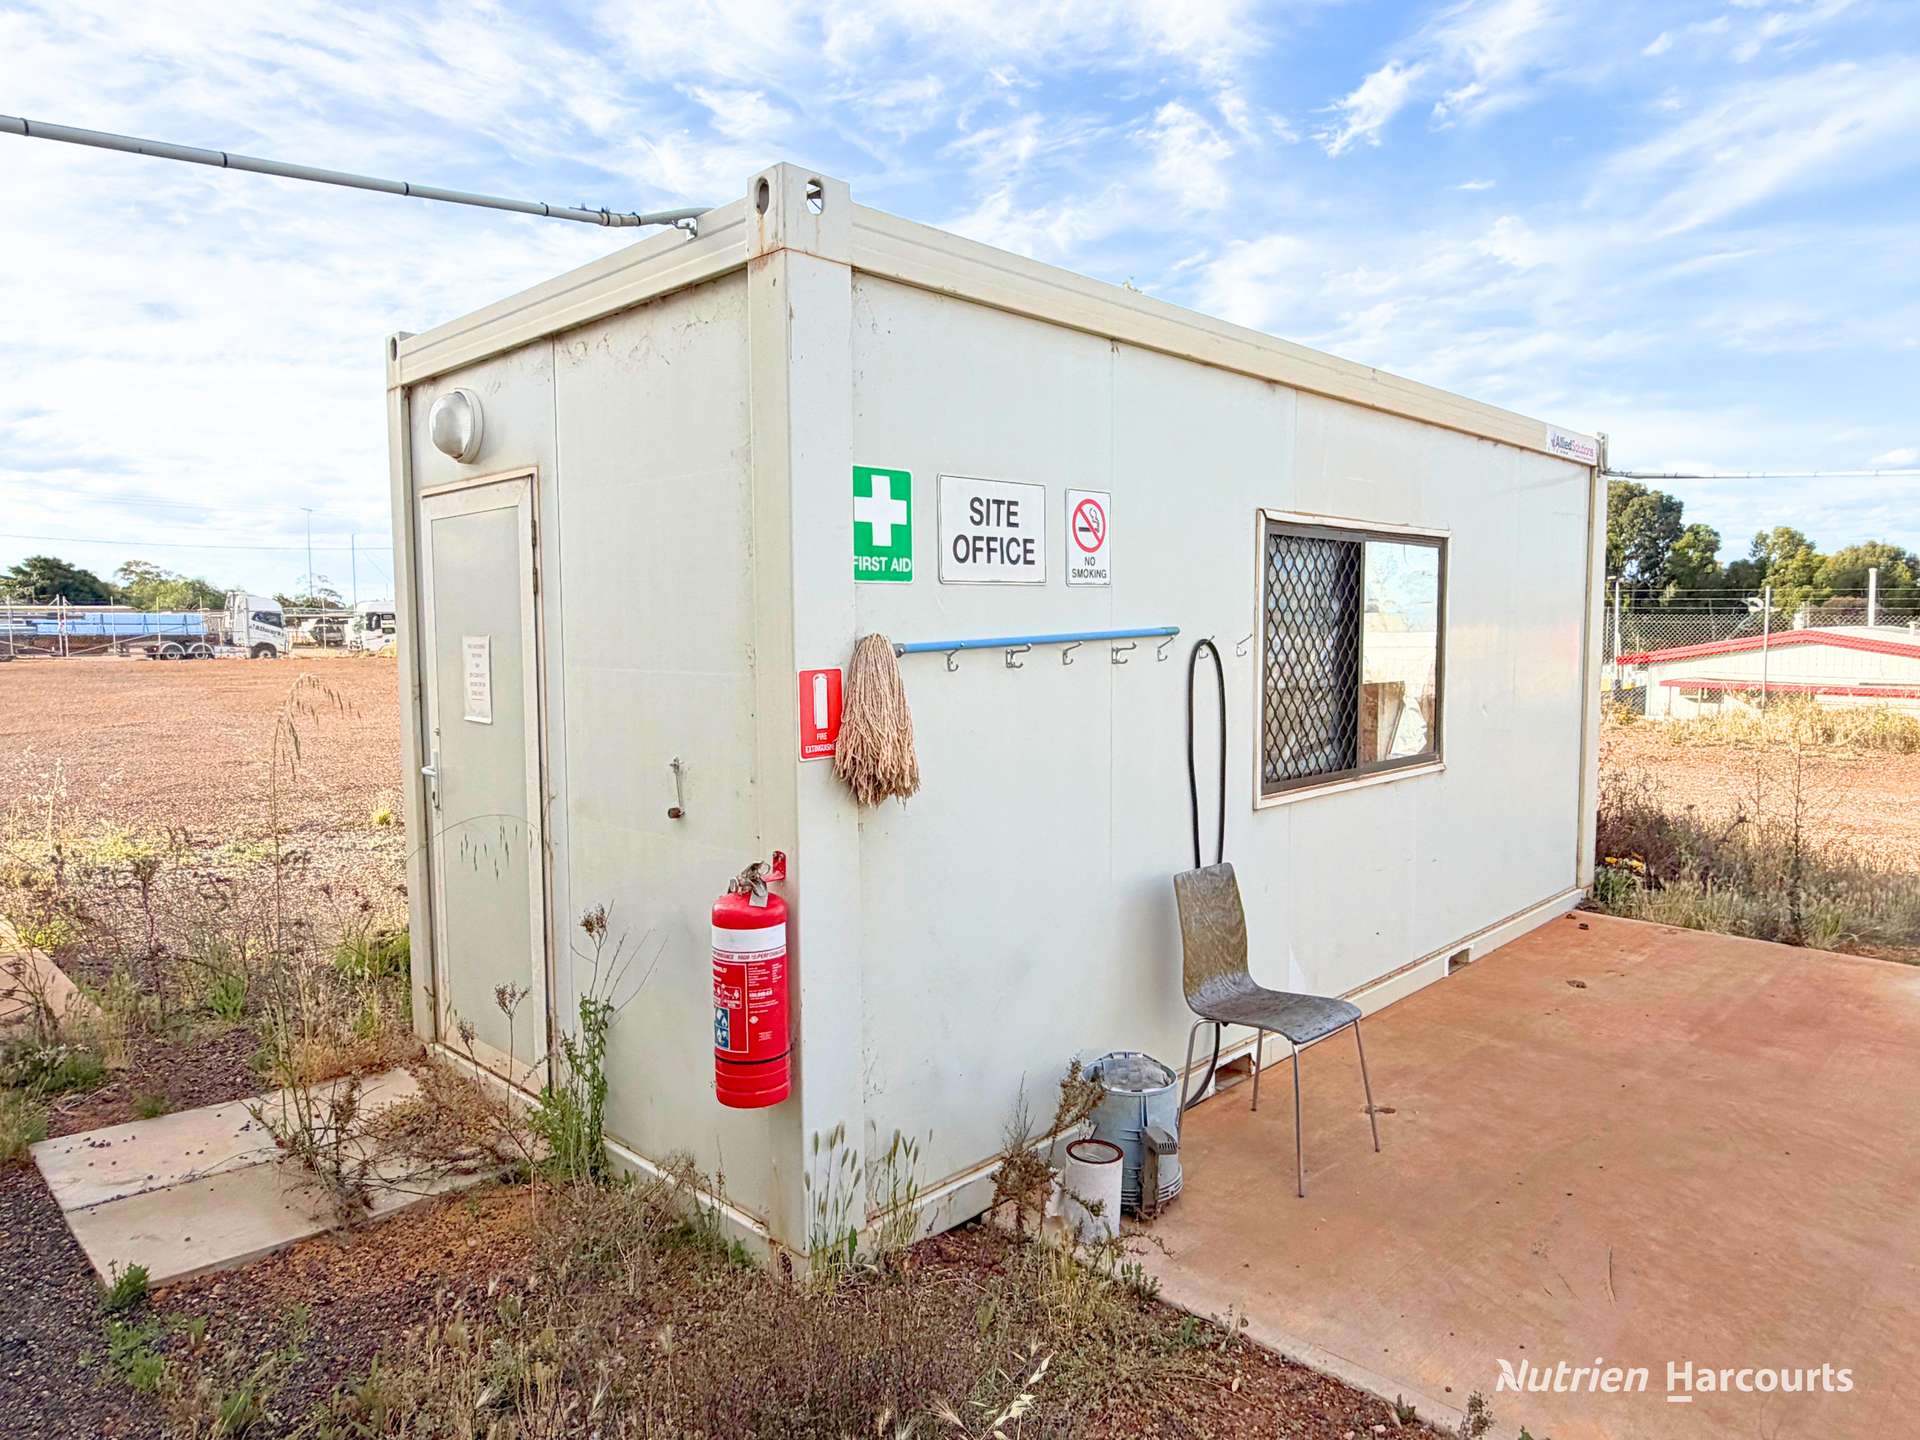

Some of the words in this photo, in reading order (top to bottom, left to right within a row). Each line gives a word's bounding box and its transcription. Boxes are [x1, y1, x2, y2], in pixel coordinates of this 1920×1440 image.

[969, 496, 1019, 528] SITE
[952, 534, 1035, 566] OFFICE
[854, 555, 888, 572] FIRST
[890, 557, 911, 572] AID
[1084, 556, 1096, 567] NO
[1071, 568, 1107, 579] SMOKING
